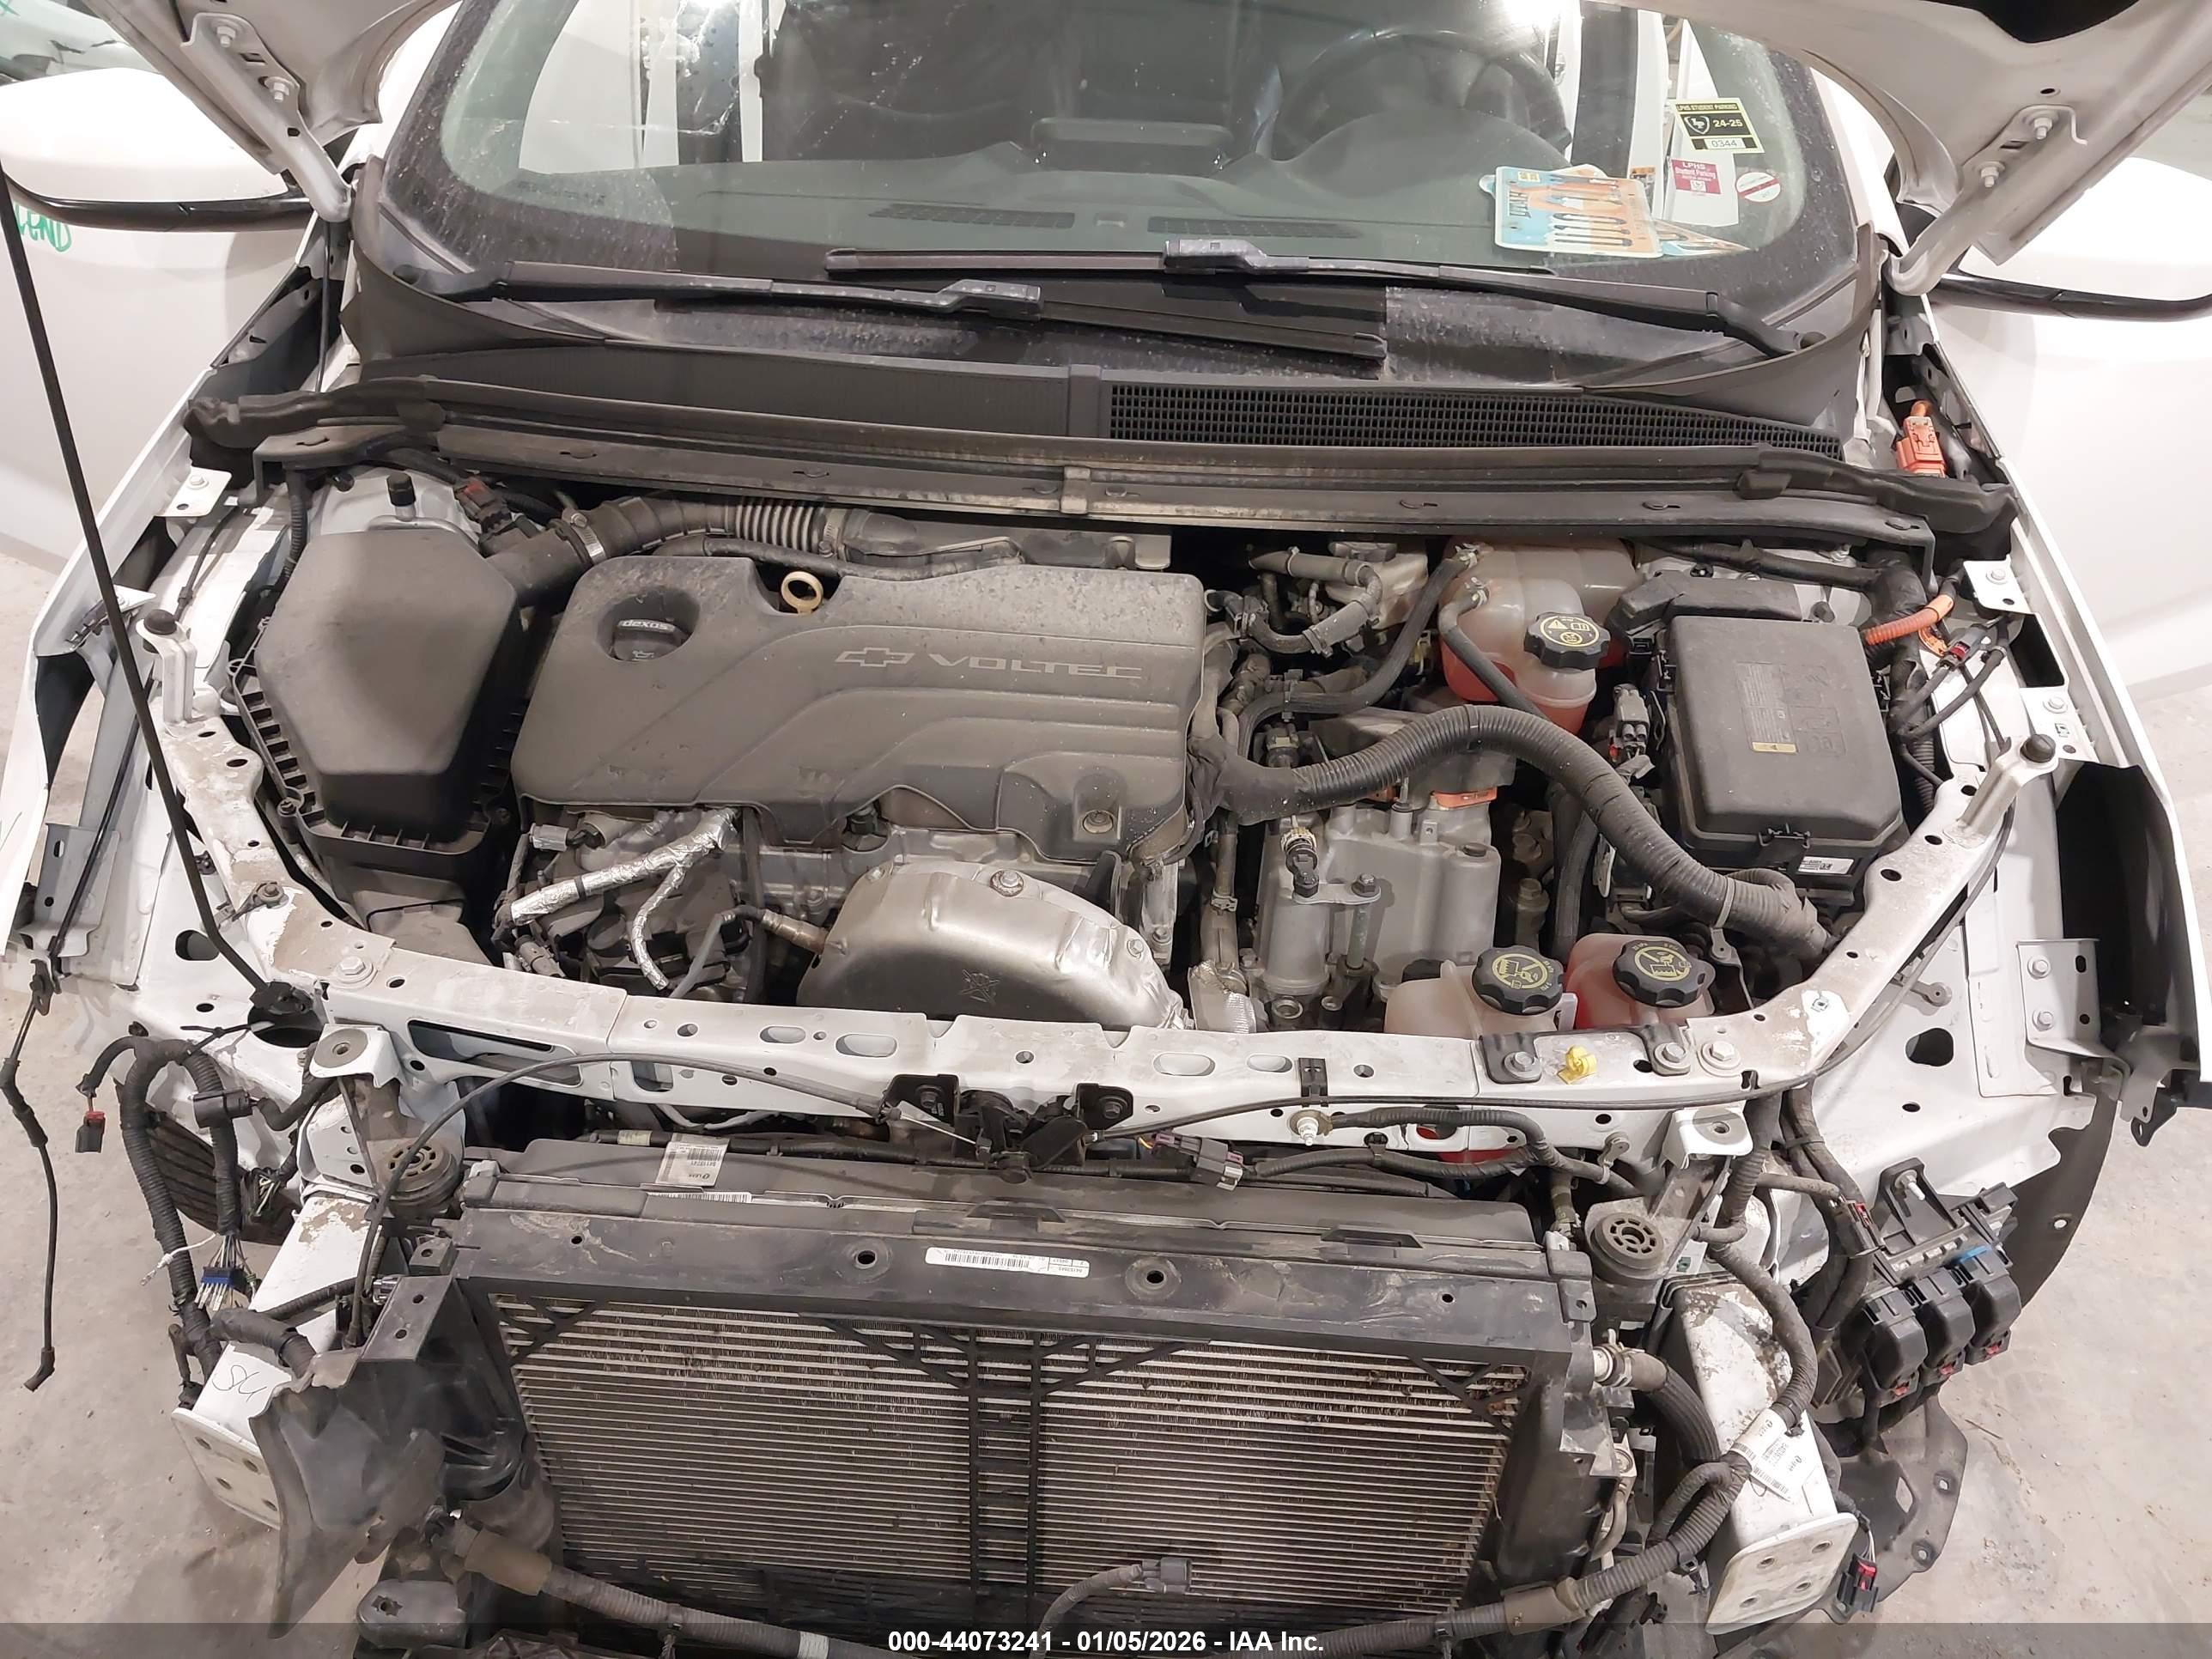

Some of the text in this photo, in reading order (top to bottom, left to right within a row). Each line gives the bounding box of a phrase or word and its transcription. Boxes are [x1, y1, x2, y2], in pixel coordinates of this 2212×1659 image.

[1712, 119, 1743, 128] 24-25
[1711, 139, 1737, 148] 0344
[1682, 161, 1706, 170] LPHS
[928, 653, 1142, 679] VOLTEC
